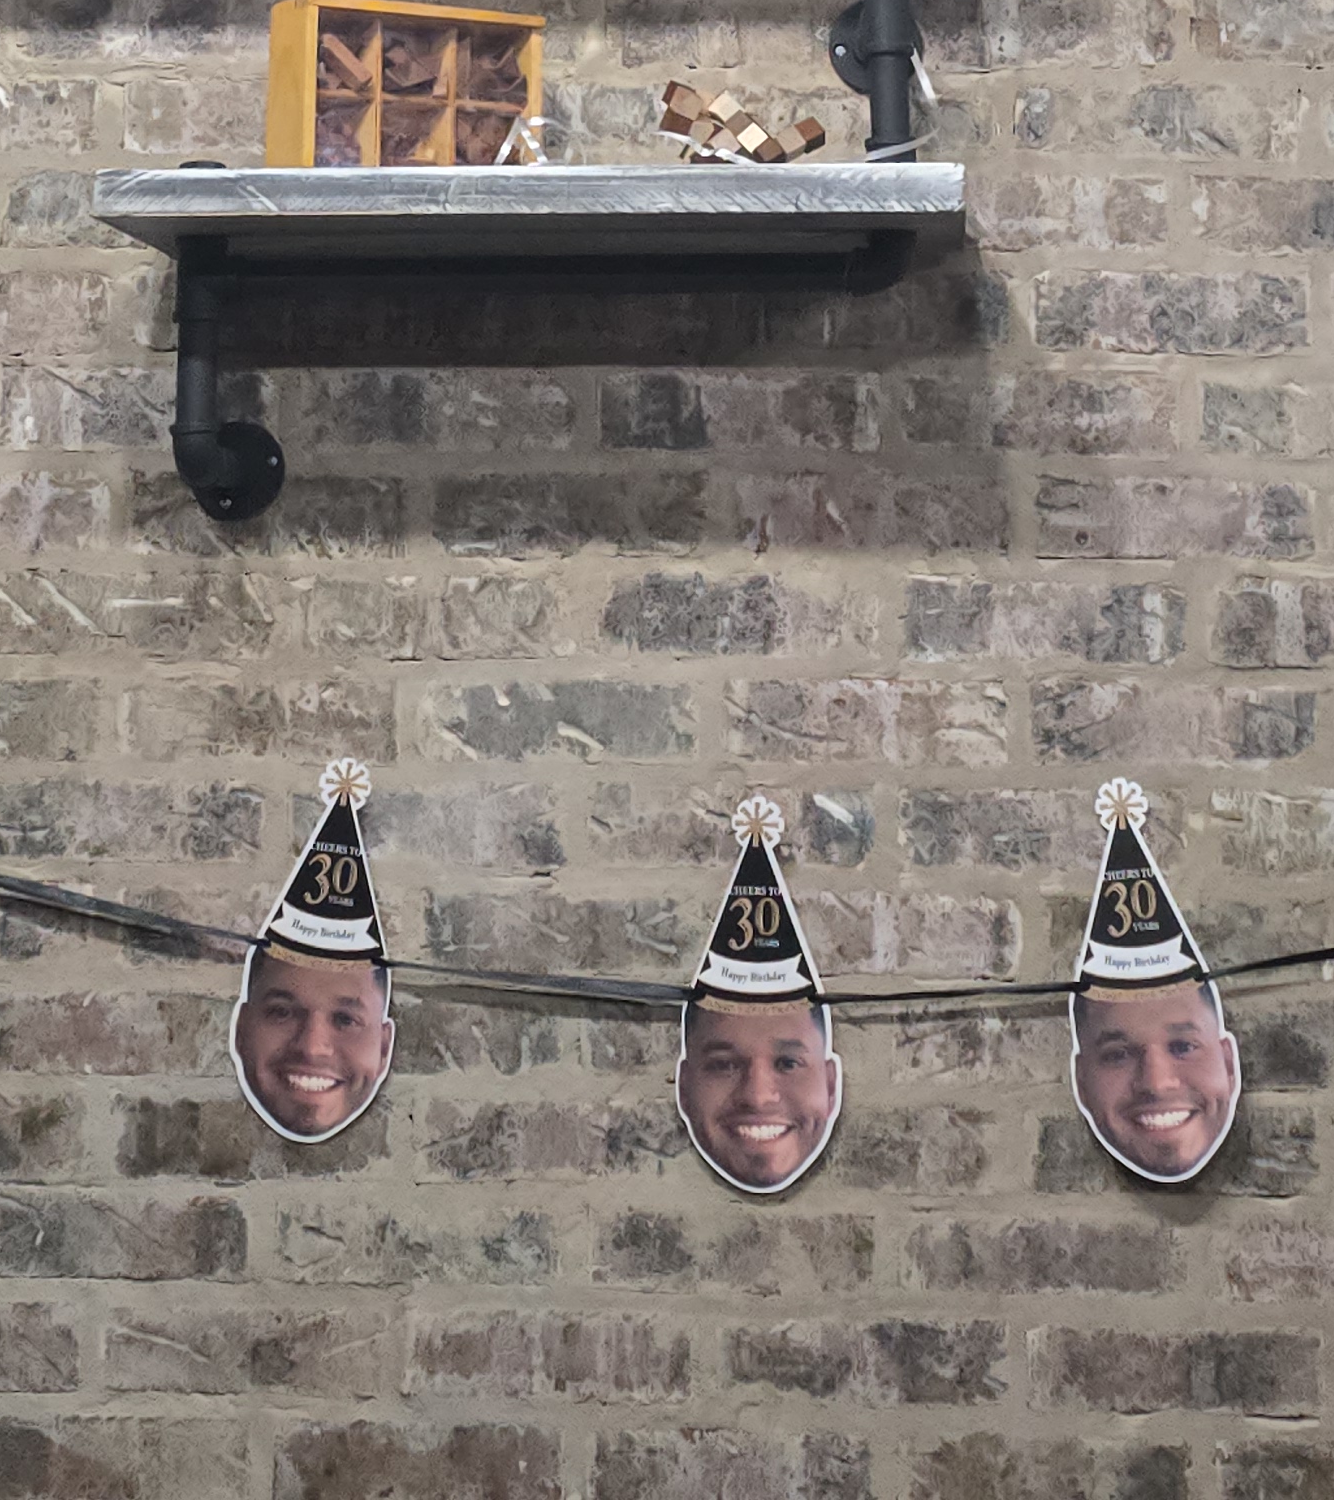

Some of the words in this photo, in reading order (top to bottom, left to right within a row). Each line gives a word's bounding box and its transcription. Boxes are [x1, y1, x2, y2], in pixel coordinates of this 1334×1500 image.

[303, 853, 358, 905] 30
[727, 897, 780, 951] 30
[1104, 879, 1157, 938] 30
[291, 919, 318, 937] Happy
[320, 927, 356, 942] Birthday
[721, 966, 748, 985] Happy
[750, 971, 786, 983] Birthday
[1104, 955, 1132, 971] Happy
[1134, 955, 1170, 967] Birthday
